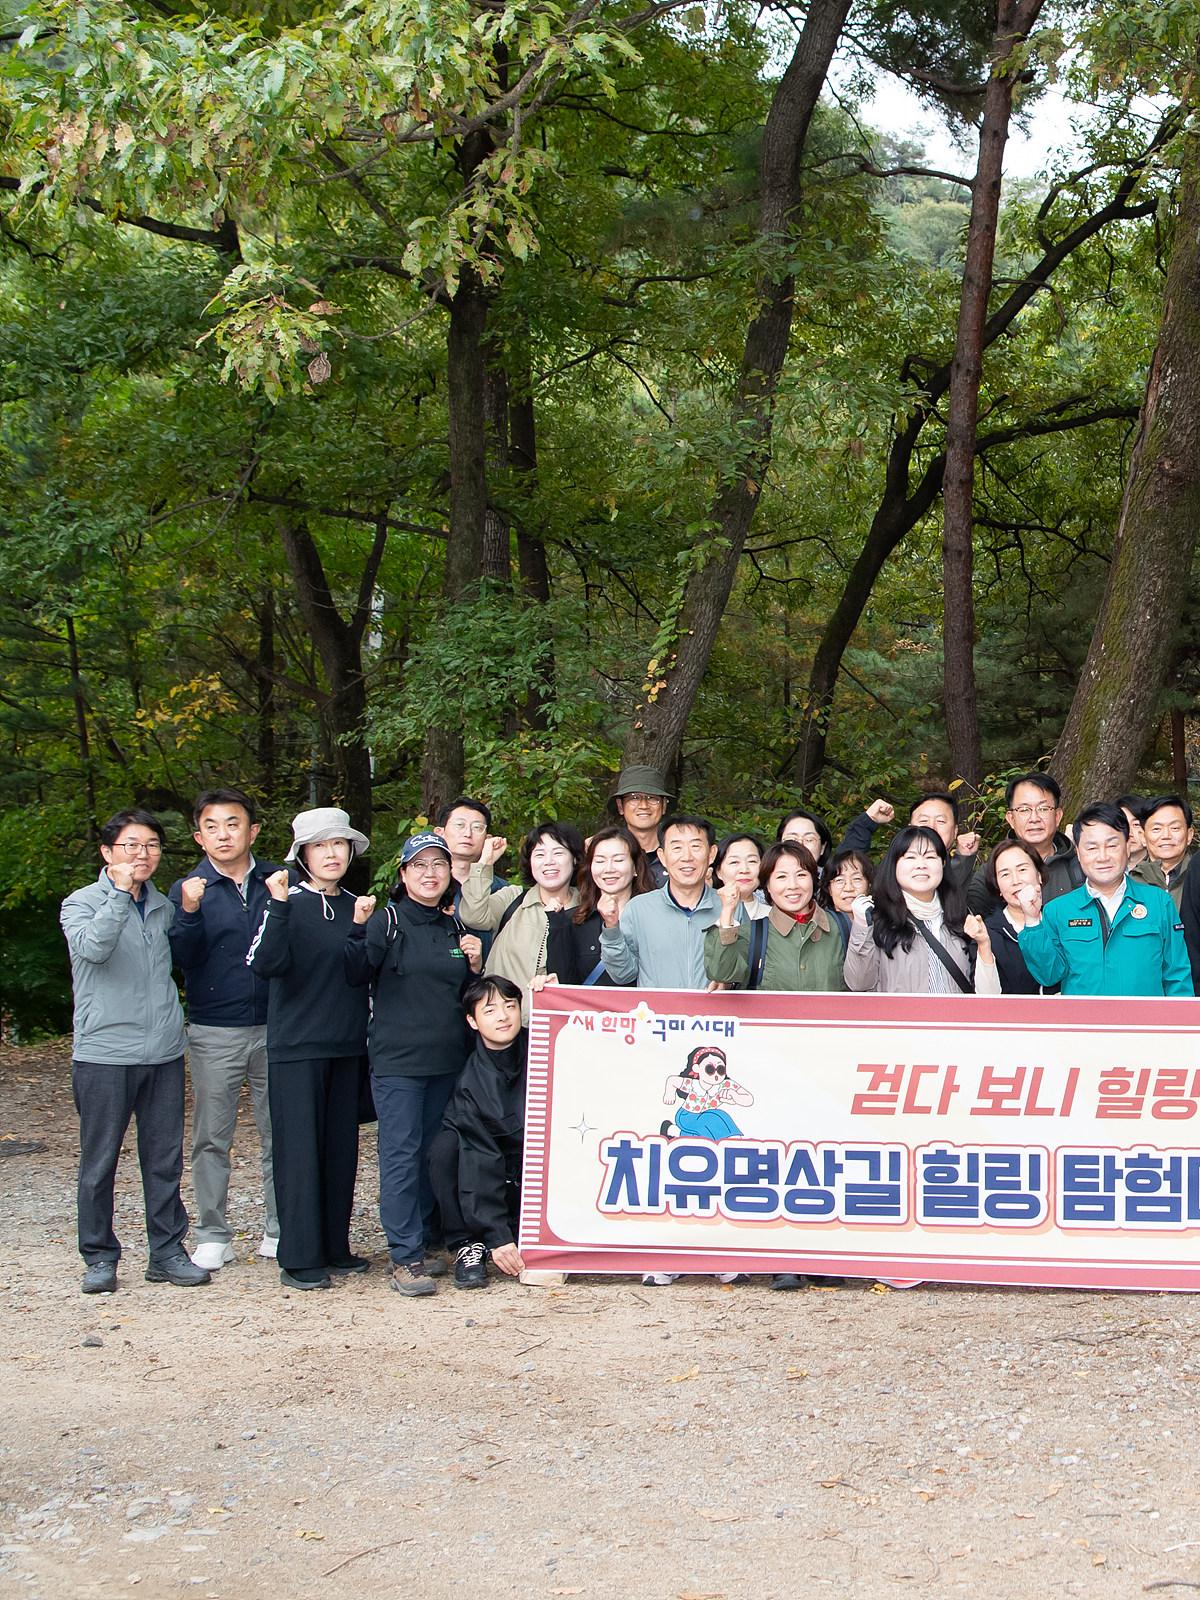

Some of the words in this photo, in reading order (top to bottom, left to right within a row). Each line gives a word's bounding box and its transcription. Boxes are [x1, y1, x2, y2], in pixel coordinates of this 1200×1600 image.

[572, 1014, 595, 1031] 새
[601, 1016, 637, 1045] 희망
[652, 1019, 685, 1042] 구미
[691, 1020, 735, 1037] 시대
[850, 1063, 960, 1116] 걷다
[970, 1066, 1081, 1117] 보니
[604, 1137, 901, 1217] 치유명상길
[922, 1148, 1041, 1220] 힐링
